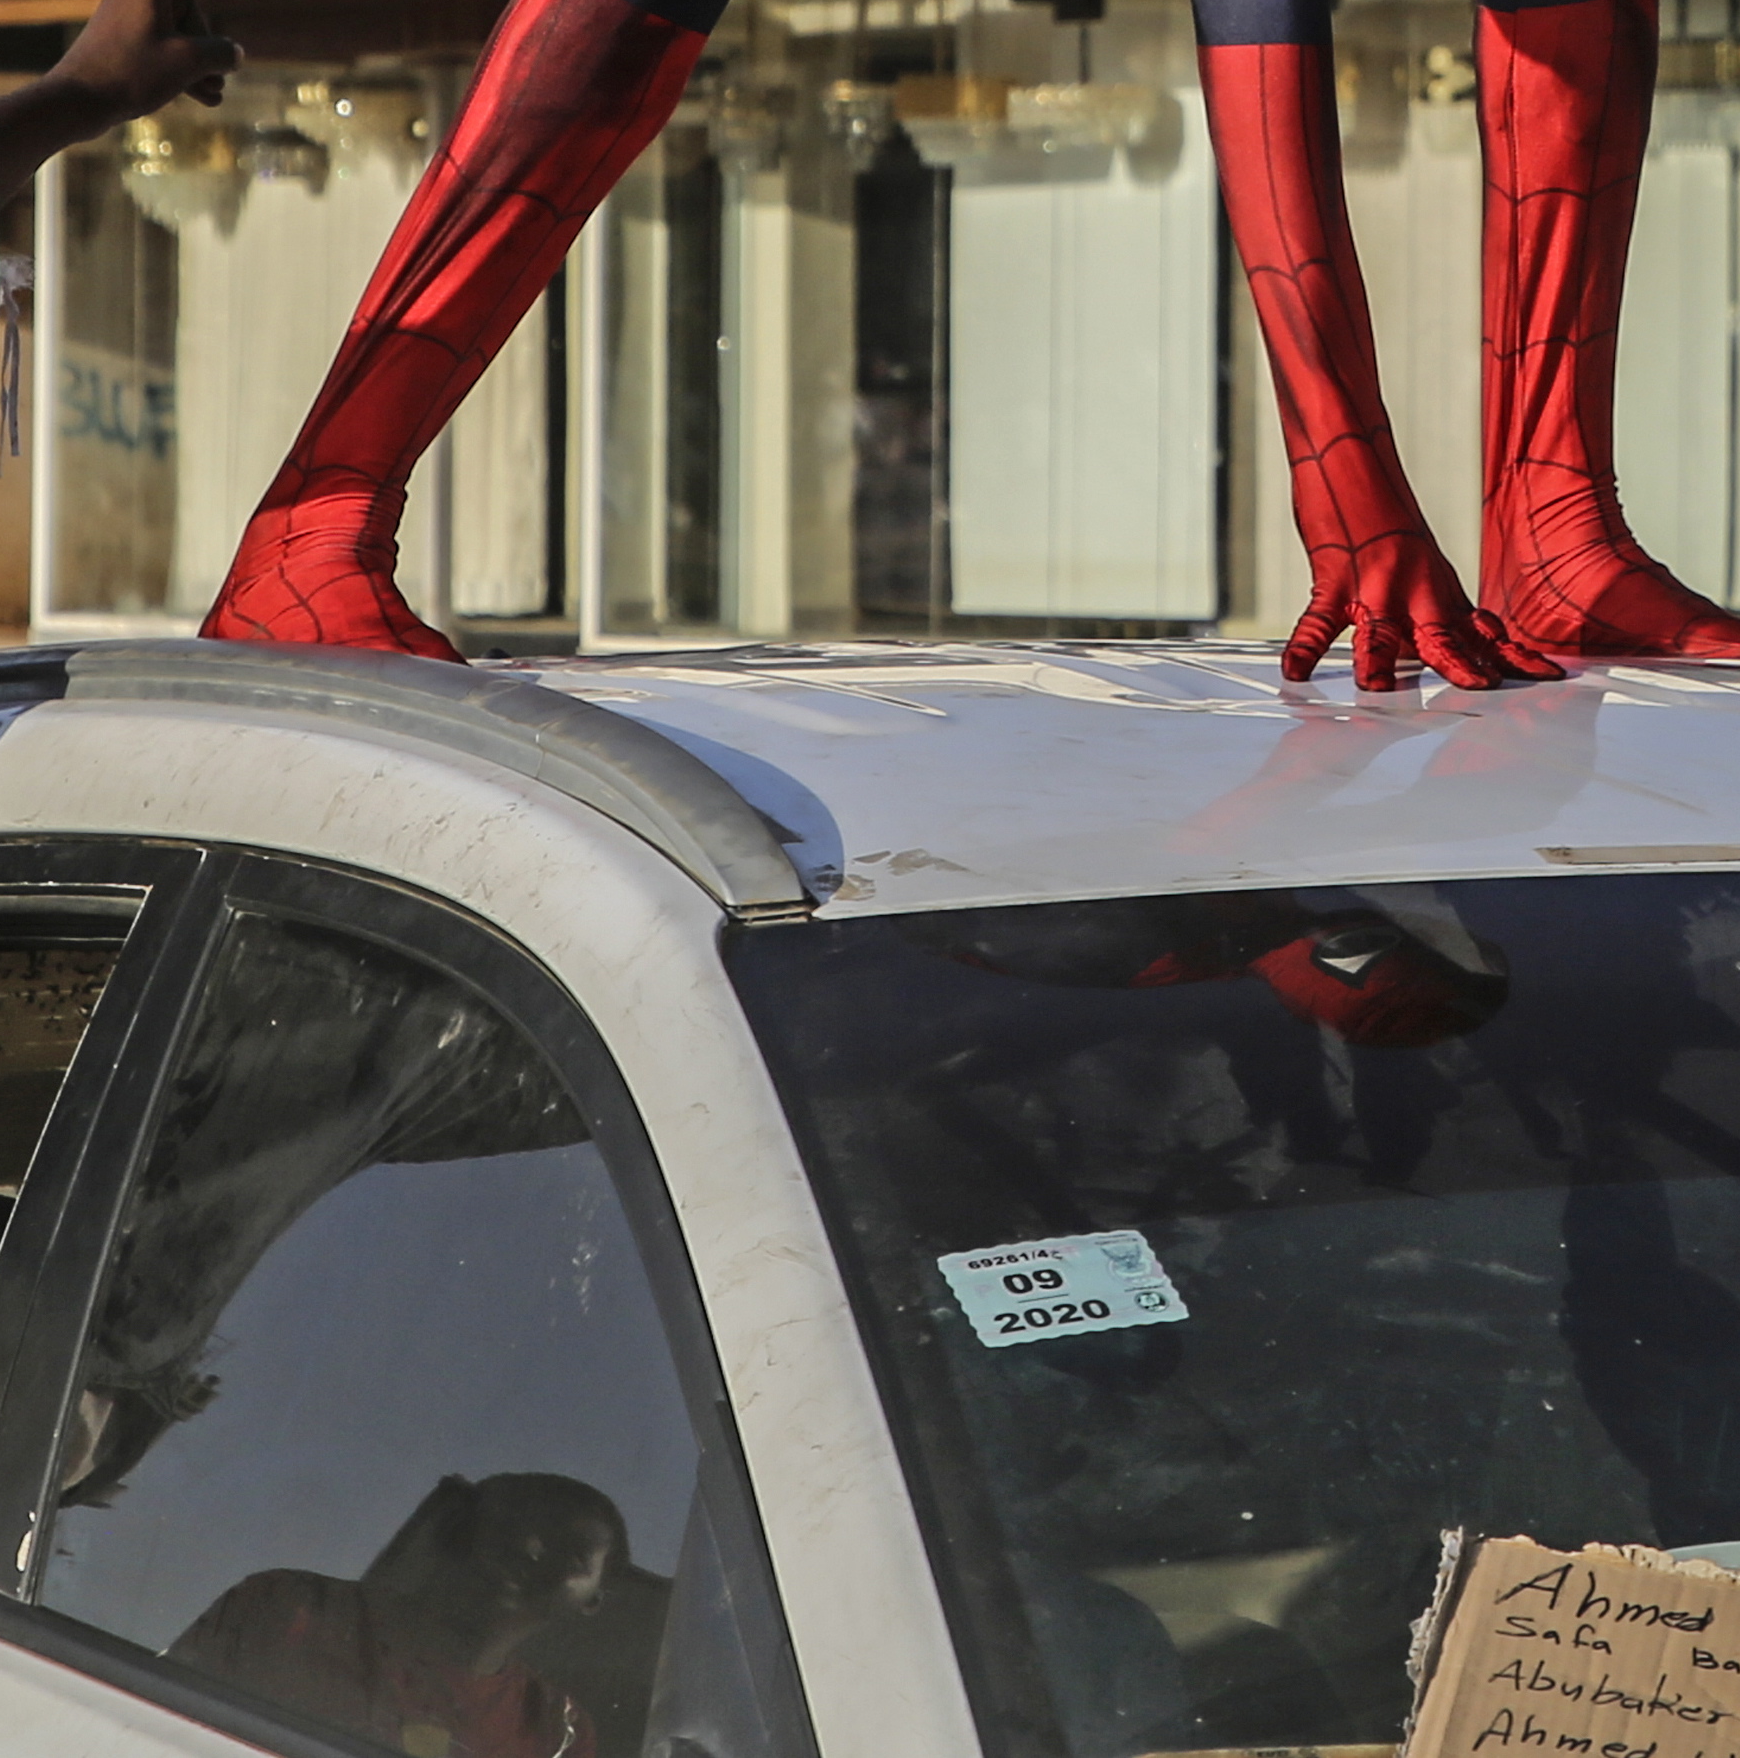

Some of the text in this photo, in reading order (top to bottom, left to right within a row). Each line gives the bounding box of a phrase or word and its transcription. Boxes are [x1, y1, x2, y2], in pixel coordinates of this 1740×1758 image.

[1002, 1268, 1064, 1295] 09
[993, 1298, 1111, 1334] 2020
[1494, 1562, 1714, 1633] Ahmed
[1494, 1615, 1613, 1656] Safa
[1471, 1707, 1658, 1758] Ahmed
